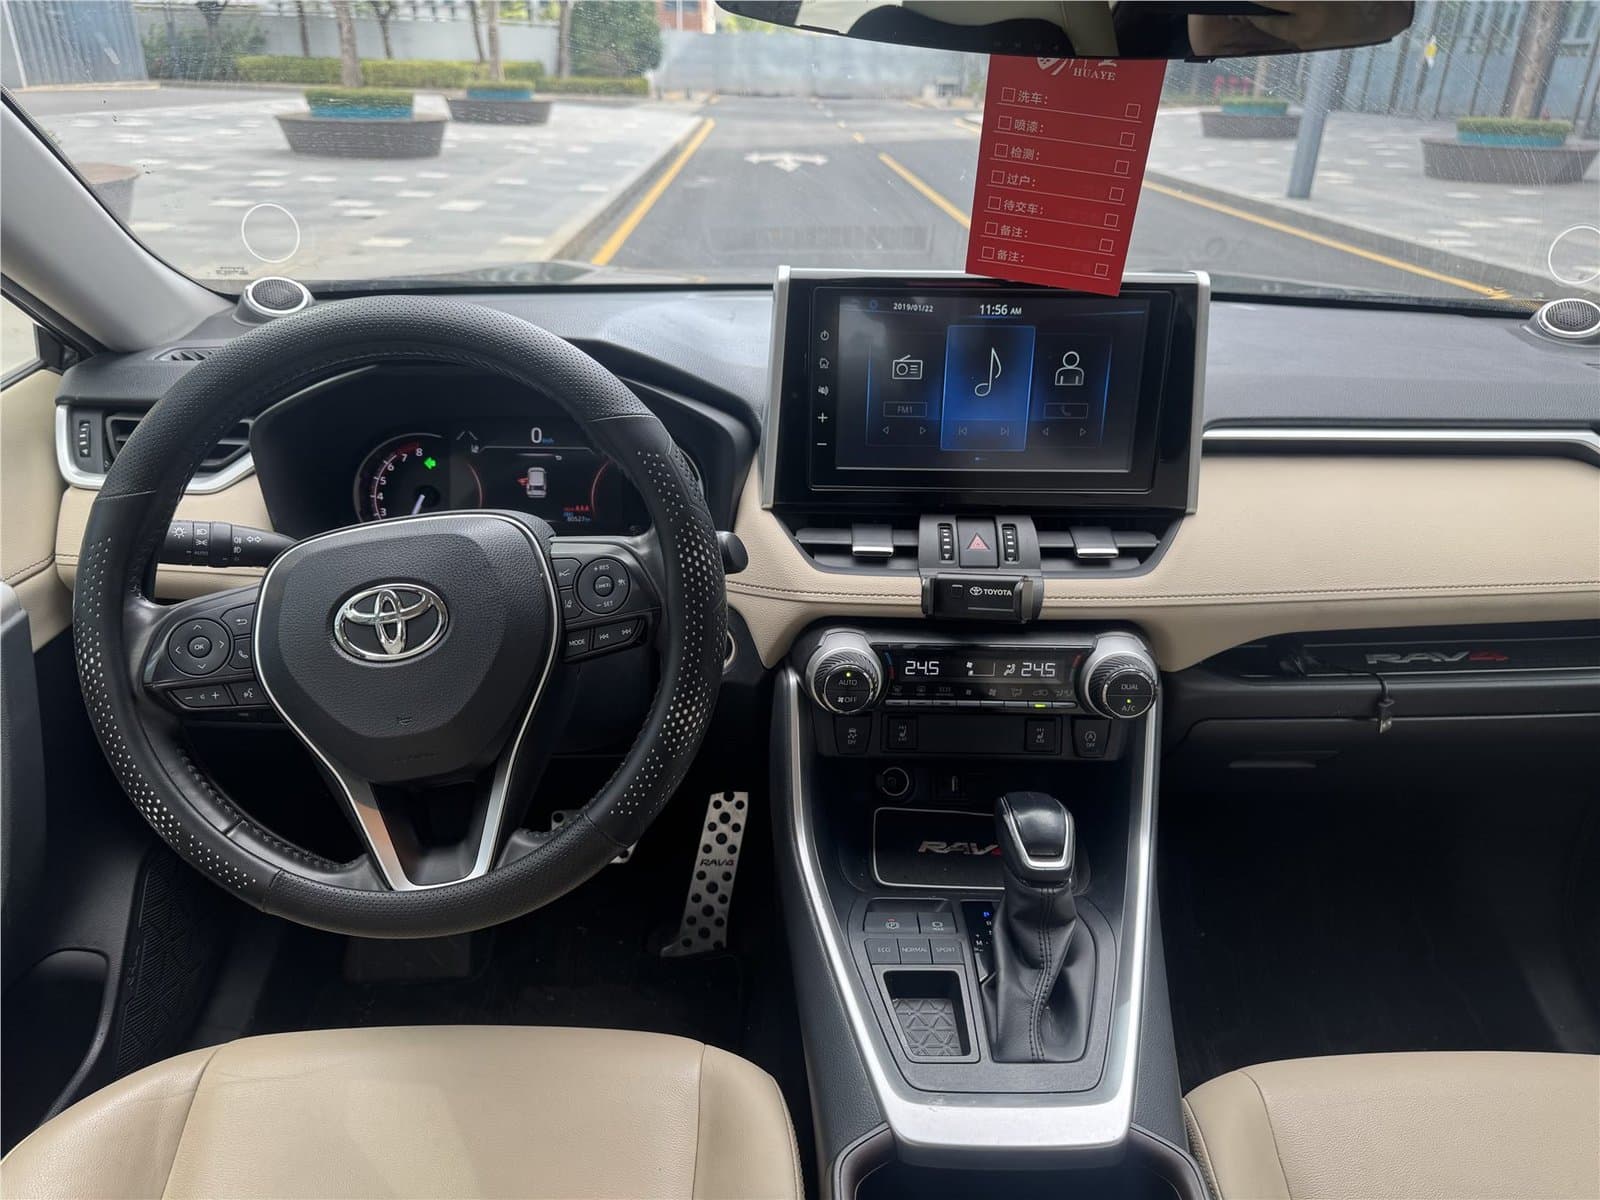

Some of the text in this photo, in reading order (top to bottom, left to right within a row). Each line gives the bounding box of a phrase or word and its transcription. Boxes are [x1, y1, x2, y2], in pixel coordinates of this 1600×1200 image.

[1073, 66, 1117, 81] HUAYE
[893, 302, 934, 313] 2019/01/22
[980, 304, 1022, 316] 11:56 AM
[531, 427, 542, 444] 0
[415, 447, 424, 457] 8
[401, 453, 408, 463] 7
[387, 463, 395, 472] 6
[380, 476, 387, 486] 5
[376, 492, 384, 501] 4
[380, 507, 387, 517] 3
[984, 588, 1013, 597] TOYOTA
[568, 638, 586, 647] MODE
[1366, 650, 1509, 664] RAV4
[838, 679, 858, 687] AUTO
[1121, 704, 1137, 712] A/C
